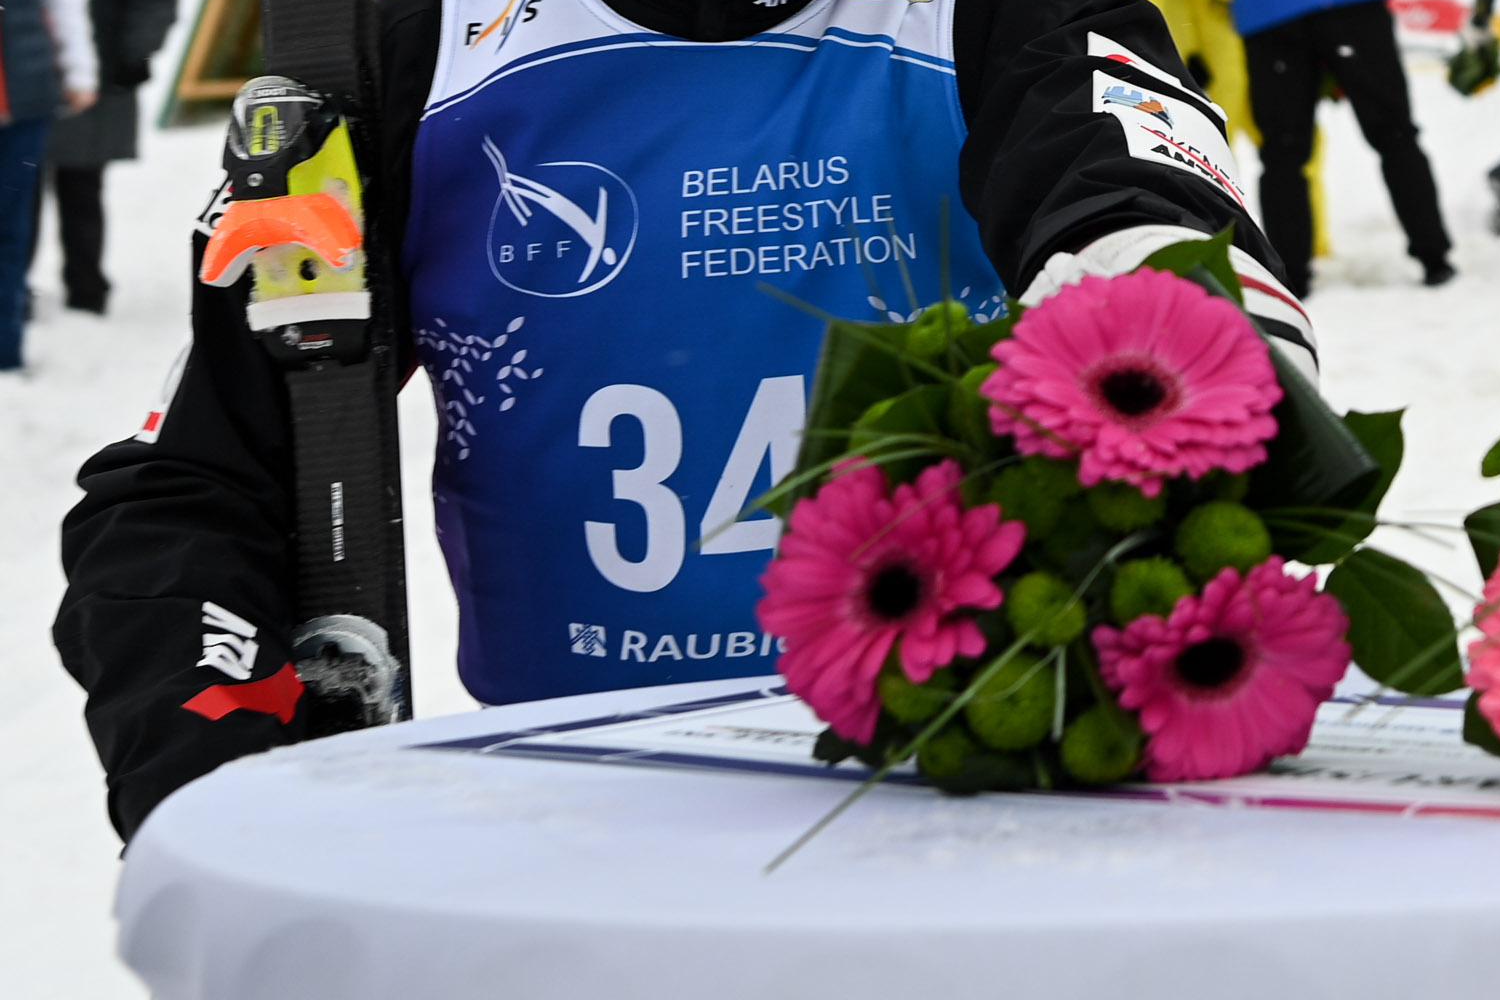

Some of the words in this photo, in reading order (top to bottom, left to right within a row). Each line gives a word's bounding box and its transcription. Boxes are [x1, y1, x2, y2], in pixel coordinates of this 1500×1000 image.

[682, 156, 849, 197] BELARUS
[681, 194, 893, 238] FREESTYLE
[681, 233, 917, 279] FEDERATION
[578, 374, 806, 593] 34
